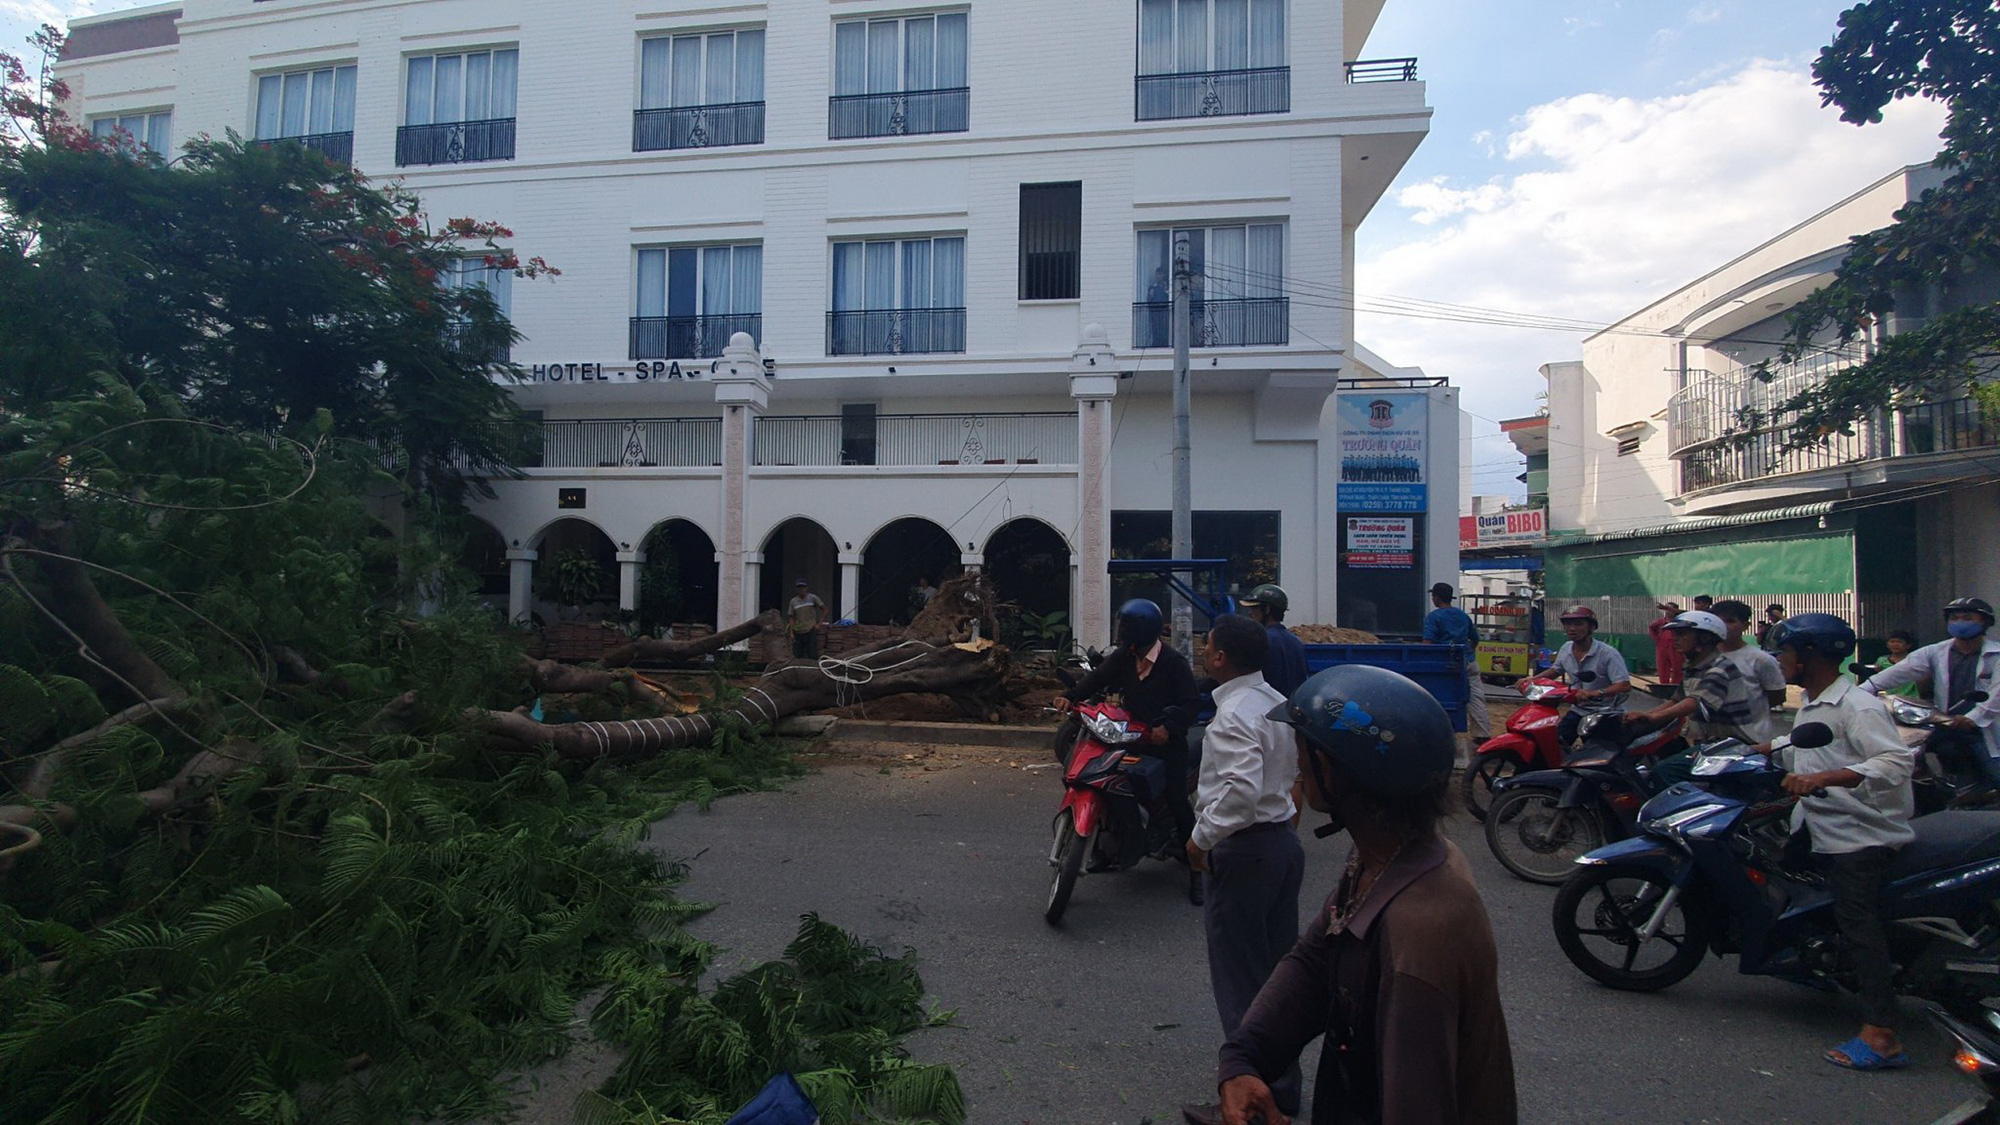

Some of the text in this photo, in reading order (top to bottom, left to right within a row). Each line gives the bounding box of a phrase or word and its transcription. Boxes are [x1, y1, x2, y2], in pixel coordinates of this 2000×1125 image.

[532, 363, 608, 382] HOTEL
[635, 360, 683, 381] SPA
[1507, 511, 1542, 534] BIBO
